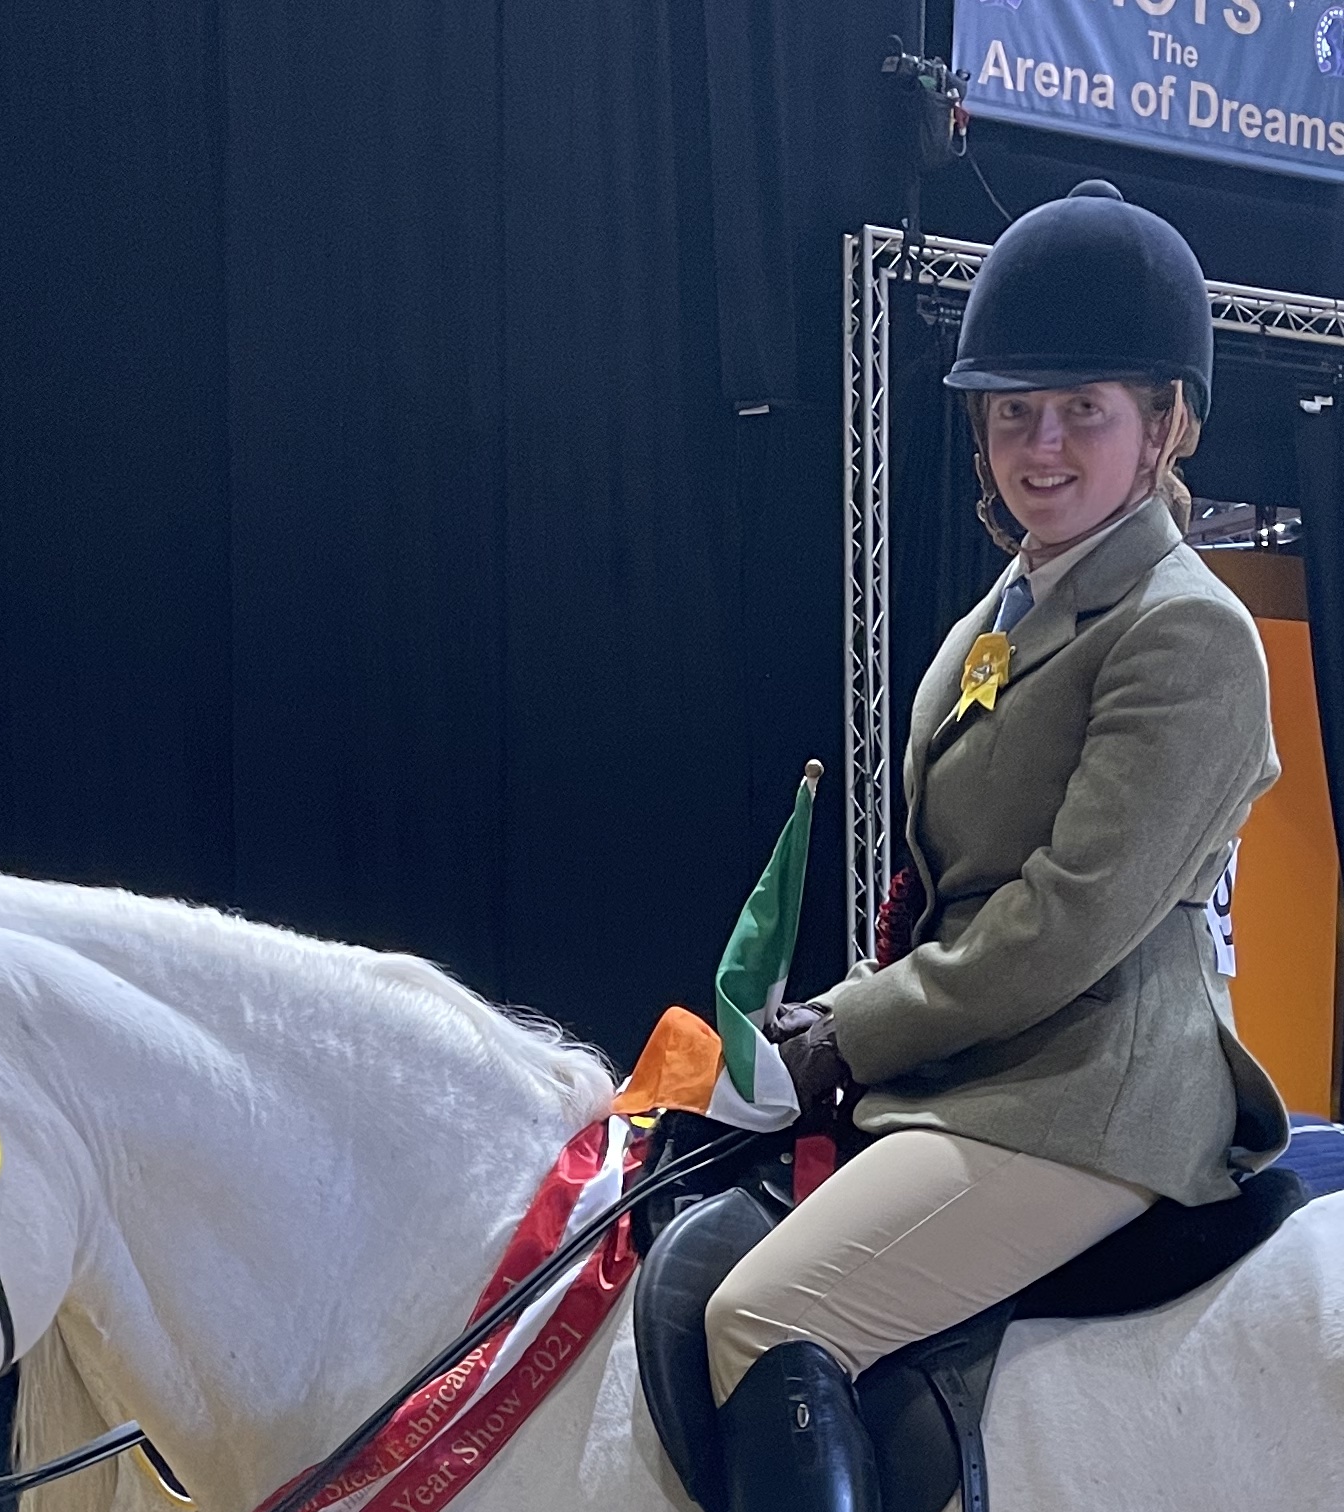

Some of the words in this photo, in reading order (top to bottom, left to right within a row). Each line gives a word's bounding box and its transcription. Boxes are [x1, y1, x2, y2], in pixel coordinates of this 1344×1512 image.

[977, 39, 1115, 111] Arena
[1131, 74, 1176, 121] of
[1147, 30, 1199, 69] The
[452, 1387, 525, 1467] Show
[521, 1320, 586, 1388] 2021
